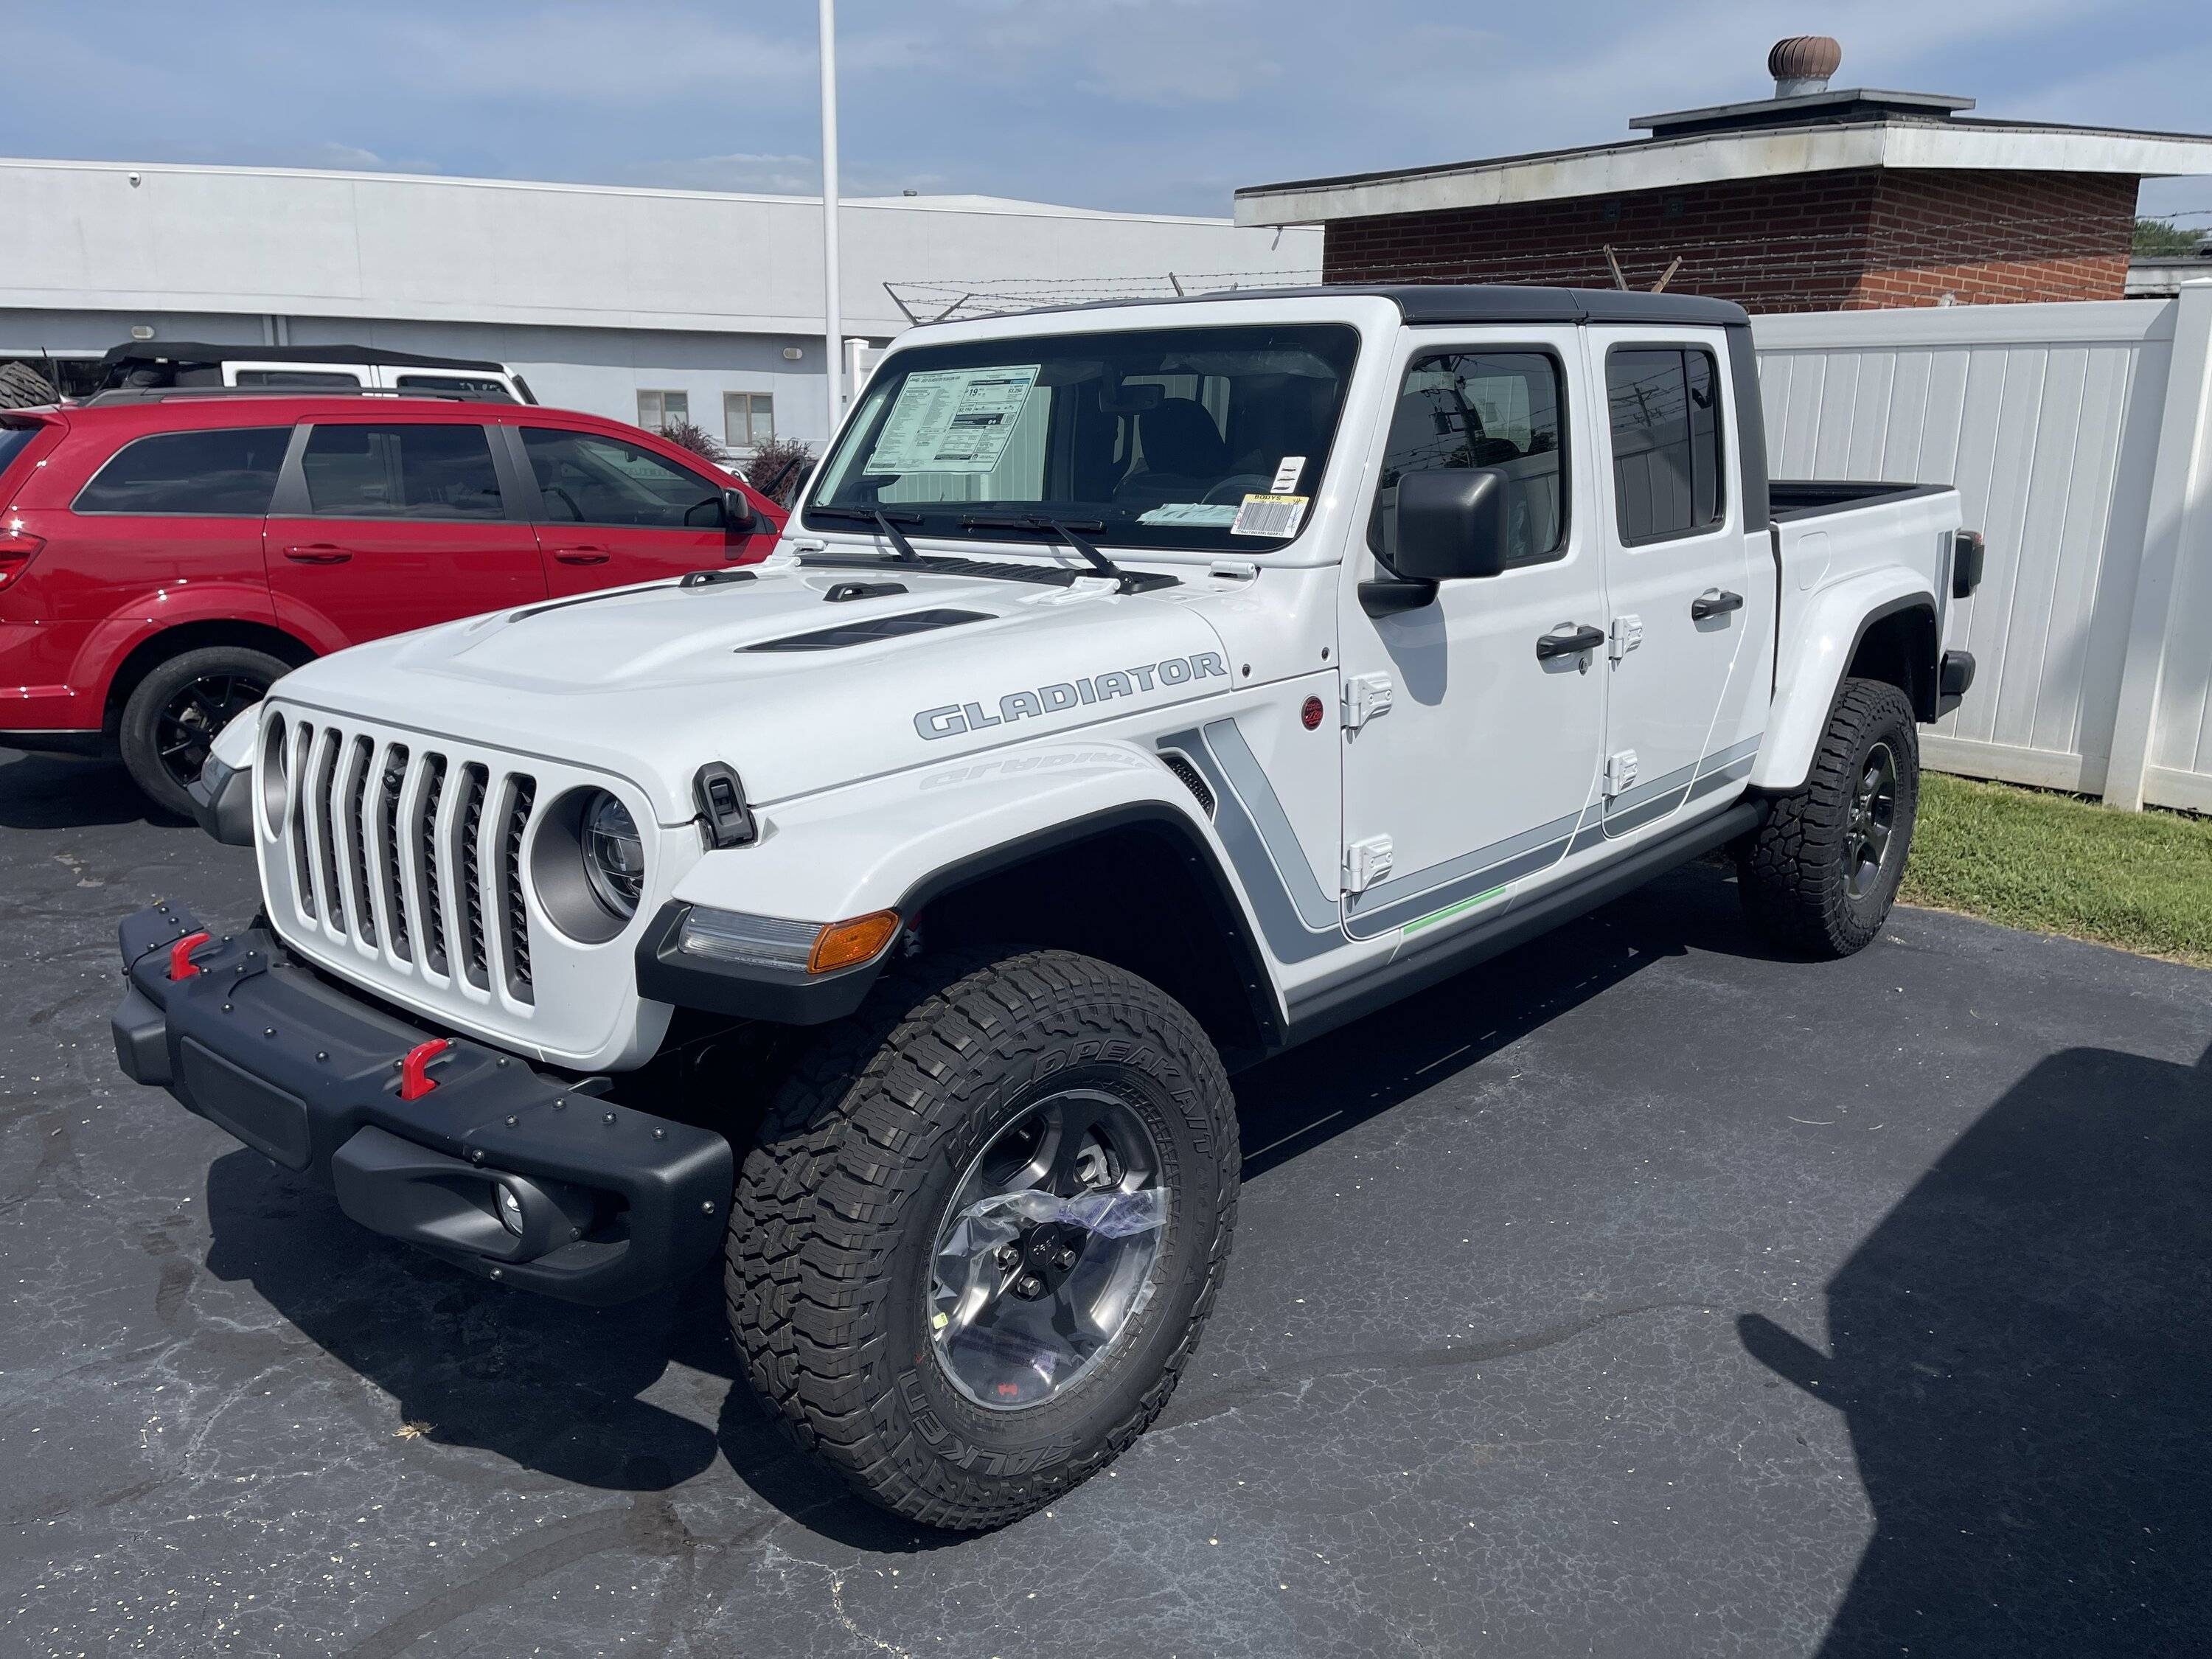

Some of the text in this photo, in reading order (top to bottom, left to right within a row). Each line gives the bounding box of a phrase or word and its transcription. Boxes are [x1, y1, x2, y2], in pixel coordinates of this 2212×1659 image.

[969, 388, 978, 396] 19
[914, 652, 1228, 740] GLADIATOR
[897, 1368, 1082, 1477] FALKEN
